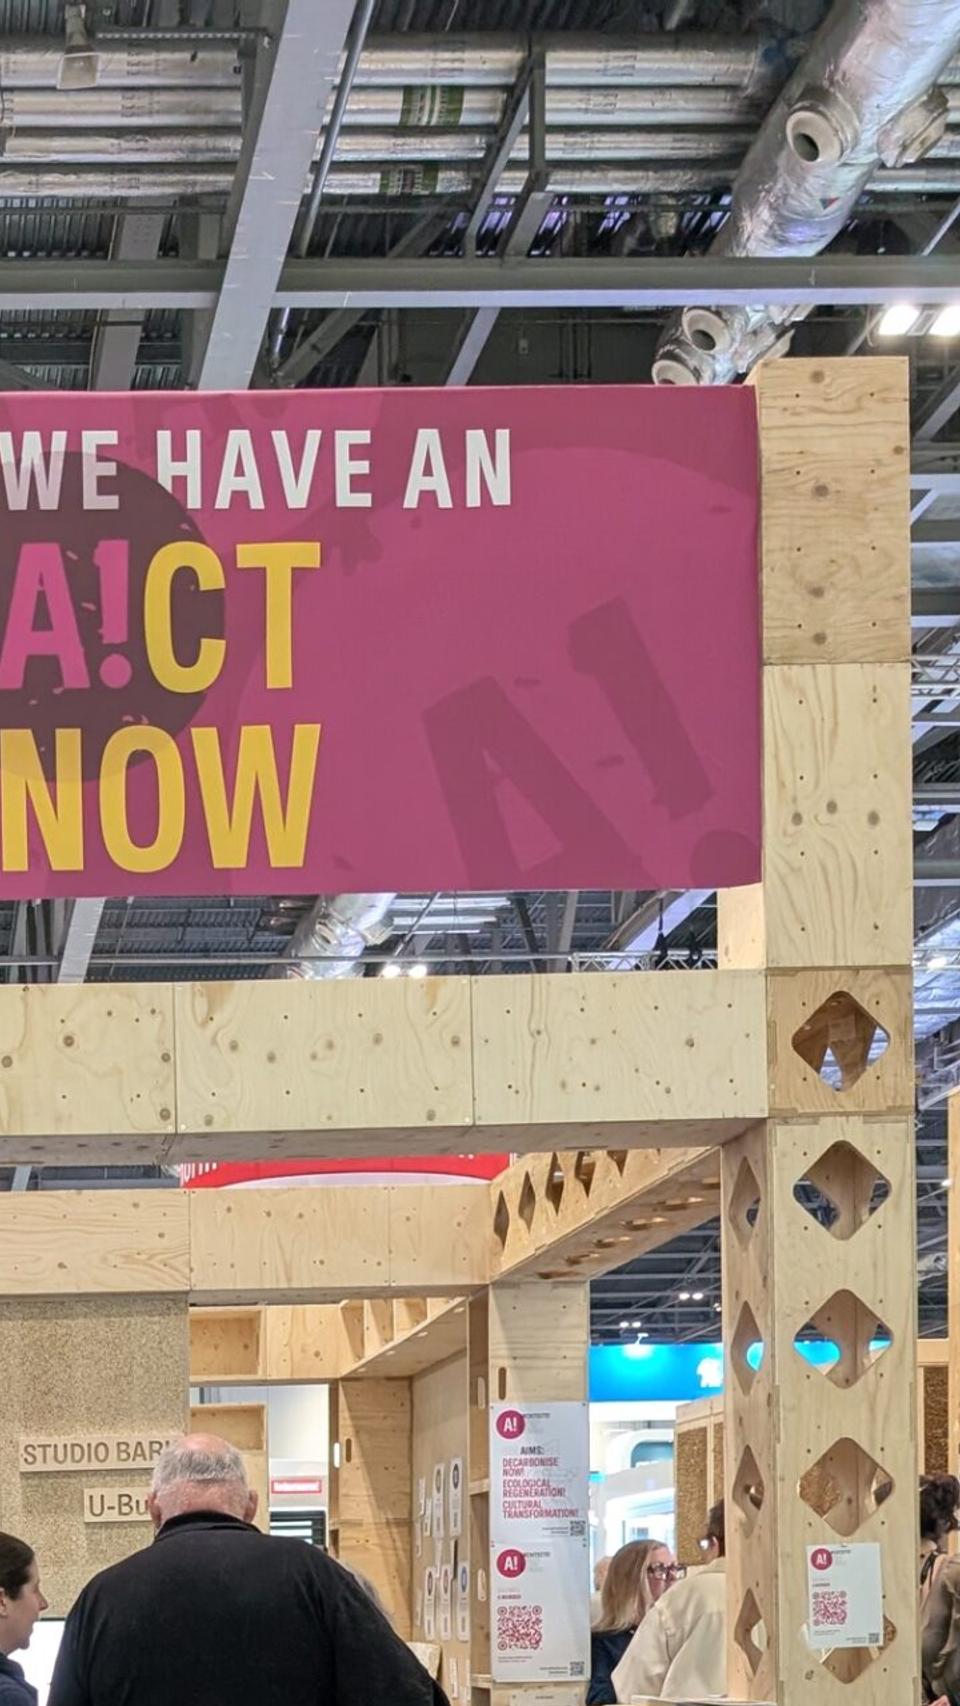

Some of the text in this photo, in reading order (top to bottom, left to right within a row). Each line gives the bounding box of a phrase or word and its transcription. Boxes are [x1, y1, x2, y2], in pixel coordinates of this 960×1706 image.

[156, 429, 372, 510] HAVE
[403, 428, 512, 508] AN
[0, 723, 322, 873] NOW
[23, 1439, 171, 1466] STUDIO BAR
[520, 1445, 545, 1456] AIMS:
[502, 1457, 560, 1468] DECARBONISE
[502, 1468, 524, 1477] NOW!
[502, 1479, 552, 1488] ECOLOGICAL
[502, 1487, 567, 1498] REGENERATION!
[502, 1500, 543, 1509] CULTURAL
[502, 1508, 580, 1519] TRANSFORMATION!
